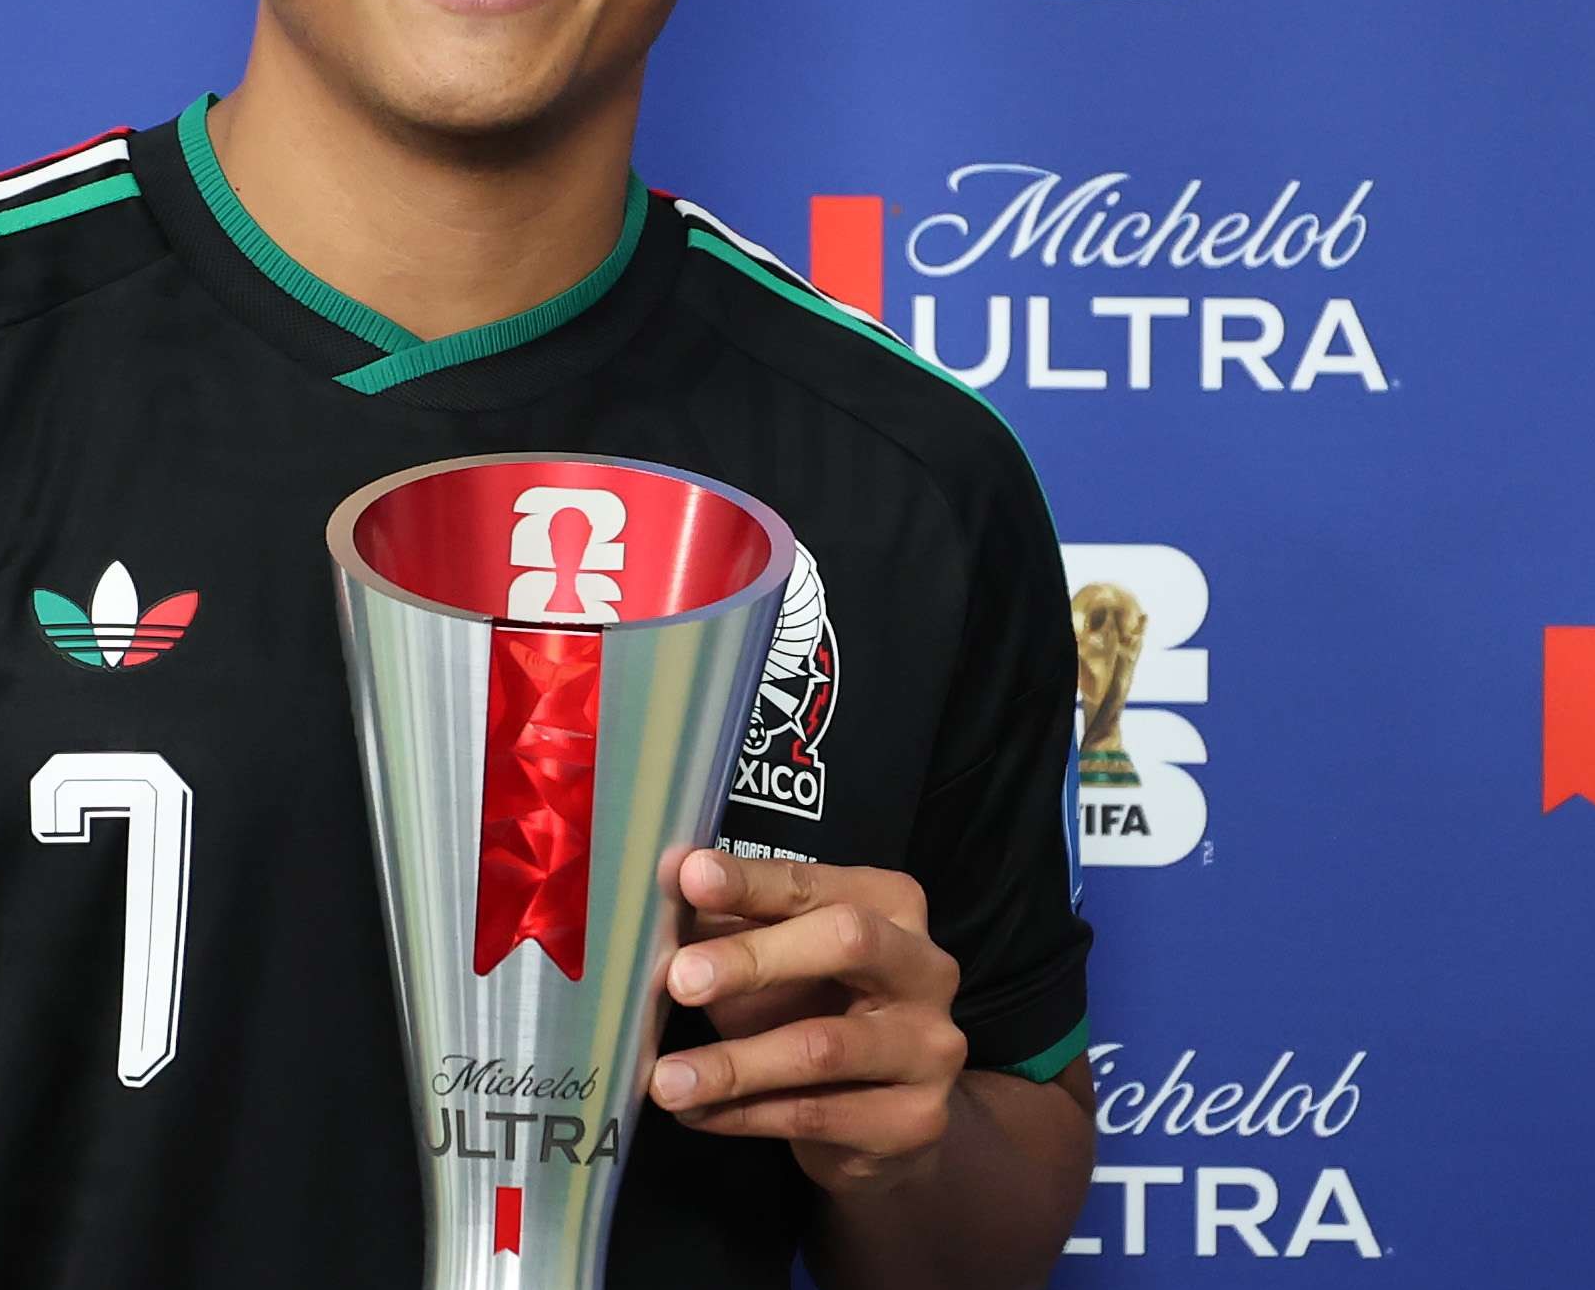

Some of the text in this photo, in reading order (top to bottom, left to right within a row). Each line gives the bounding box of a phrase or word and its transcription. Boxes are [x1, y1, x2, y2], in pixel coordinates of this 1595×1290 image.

[907, 164, 1373, 276] Michelob
[913, 295, 1388, 391] ULTRA
[734, 758, 818, 806] XICO
[1080, 803, 1150, 836] IFA
[30, 753, 193, 1088] 7
[432, 1055, 600, 1101] Michelob
[1088, 1043, 1367, 1137] chelob
[1063, 1166, 1381, 1258] TRA
